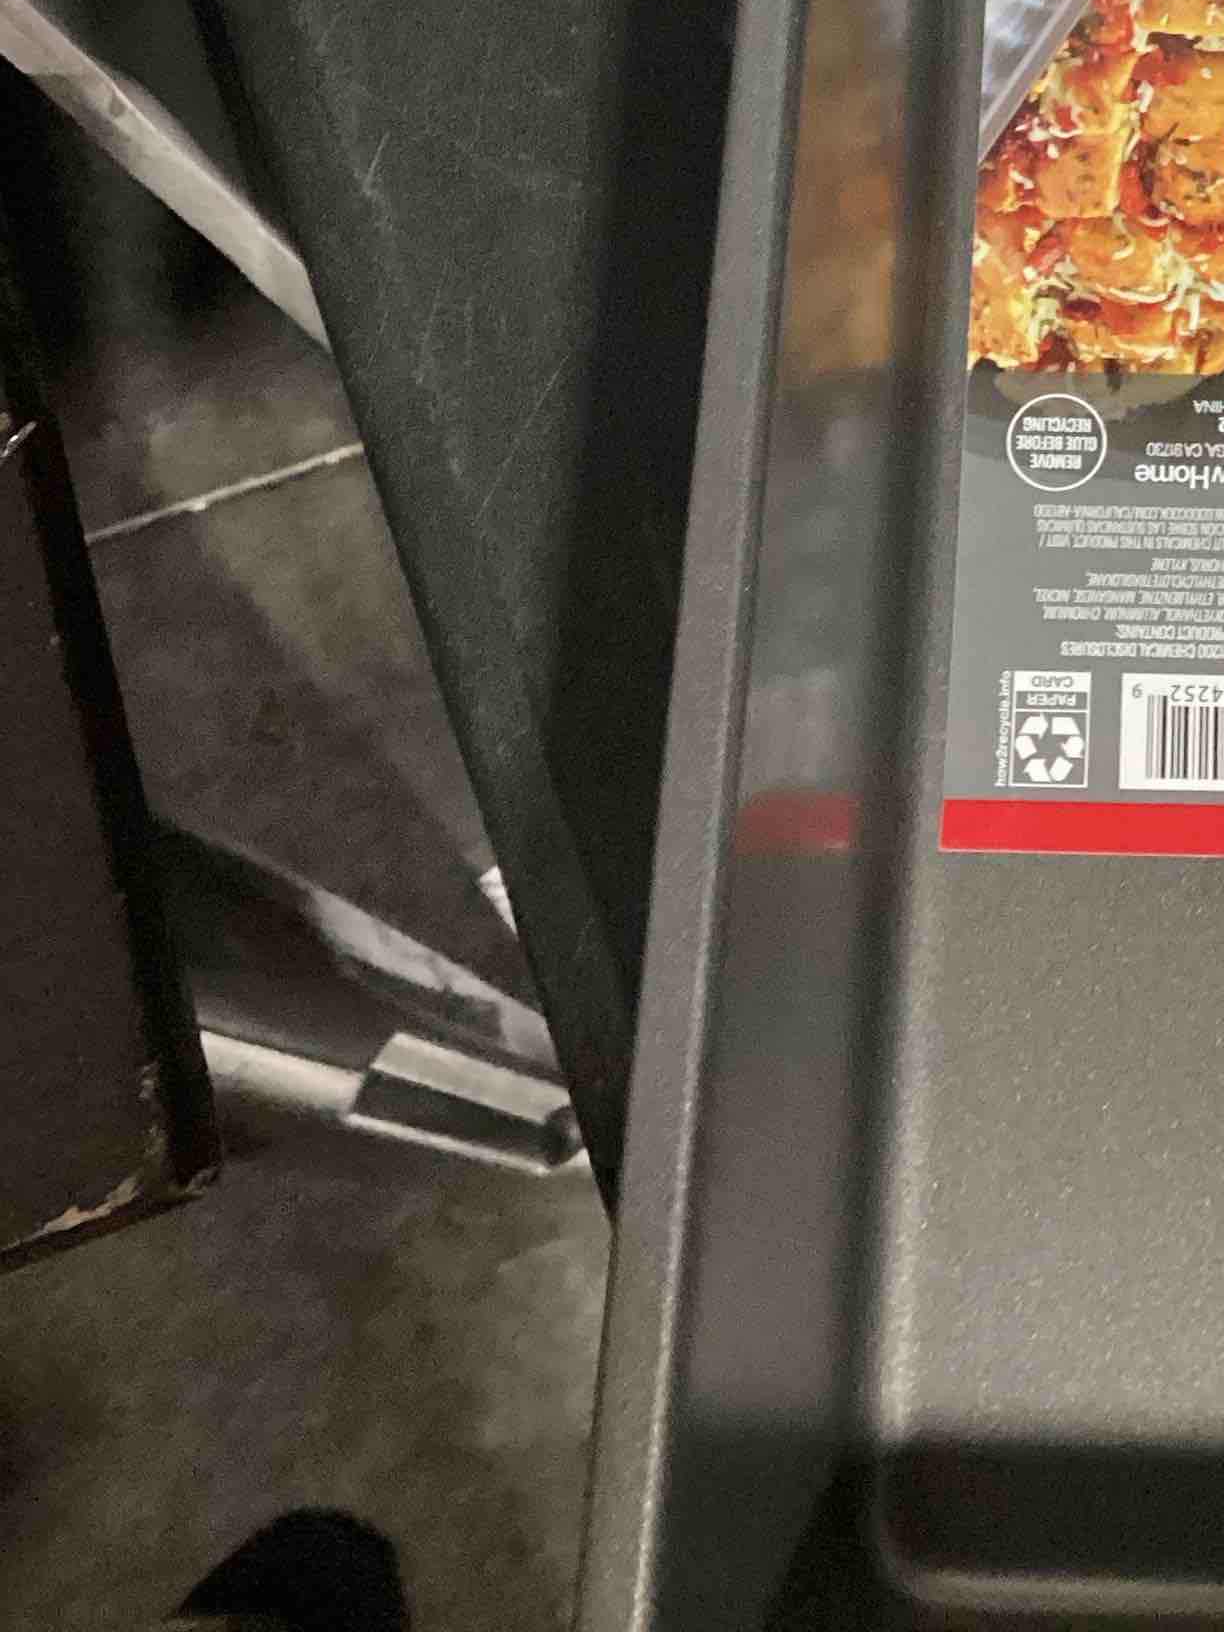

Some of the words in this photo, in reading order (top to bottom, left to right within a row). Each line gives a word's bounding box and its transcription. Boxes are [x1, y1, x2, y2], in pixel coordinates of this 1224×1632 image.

[1023, 416, 1092, 433] RECYCLING
[1016, 435, 1064, 450] BEFORE
[1065, 436, 1098, 452] GLUE
[1029, 454, 1082, 469] REMOVE
[1032, 676, 1073, 688] CARD
[1026, 693, 1076, 706] PAPER
